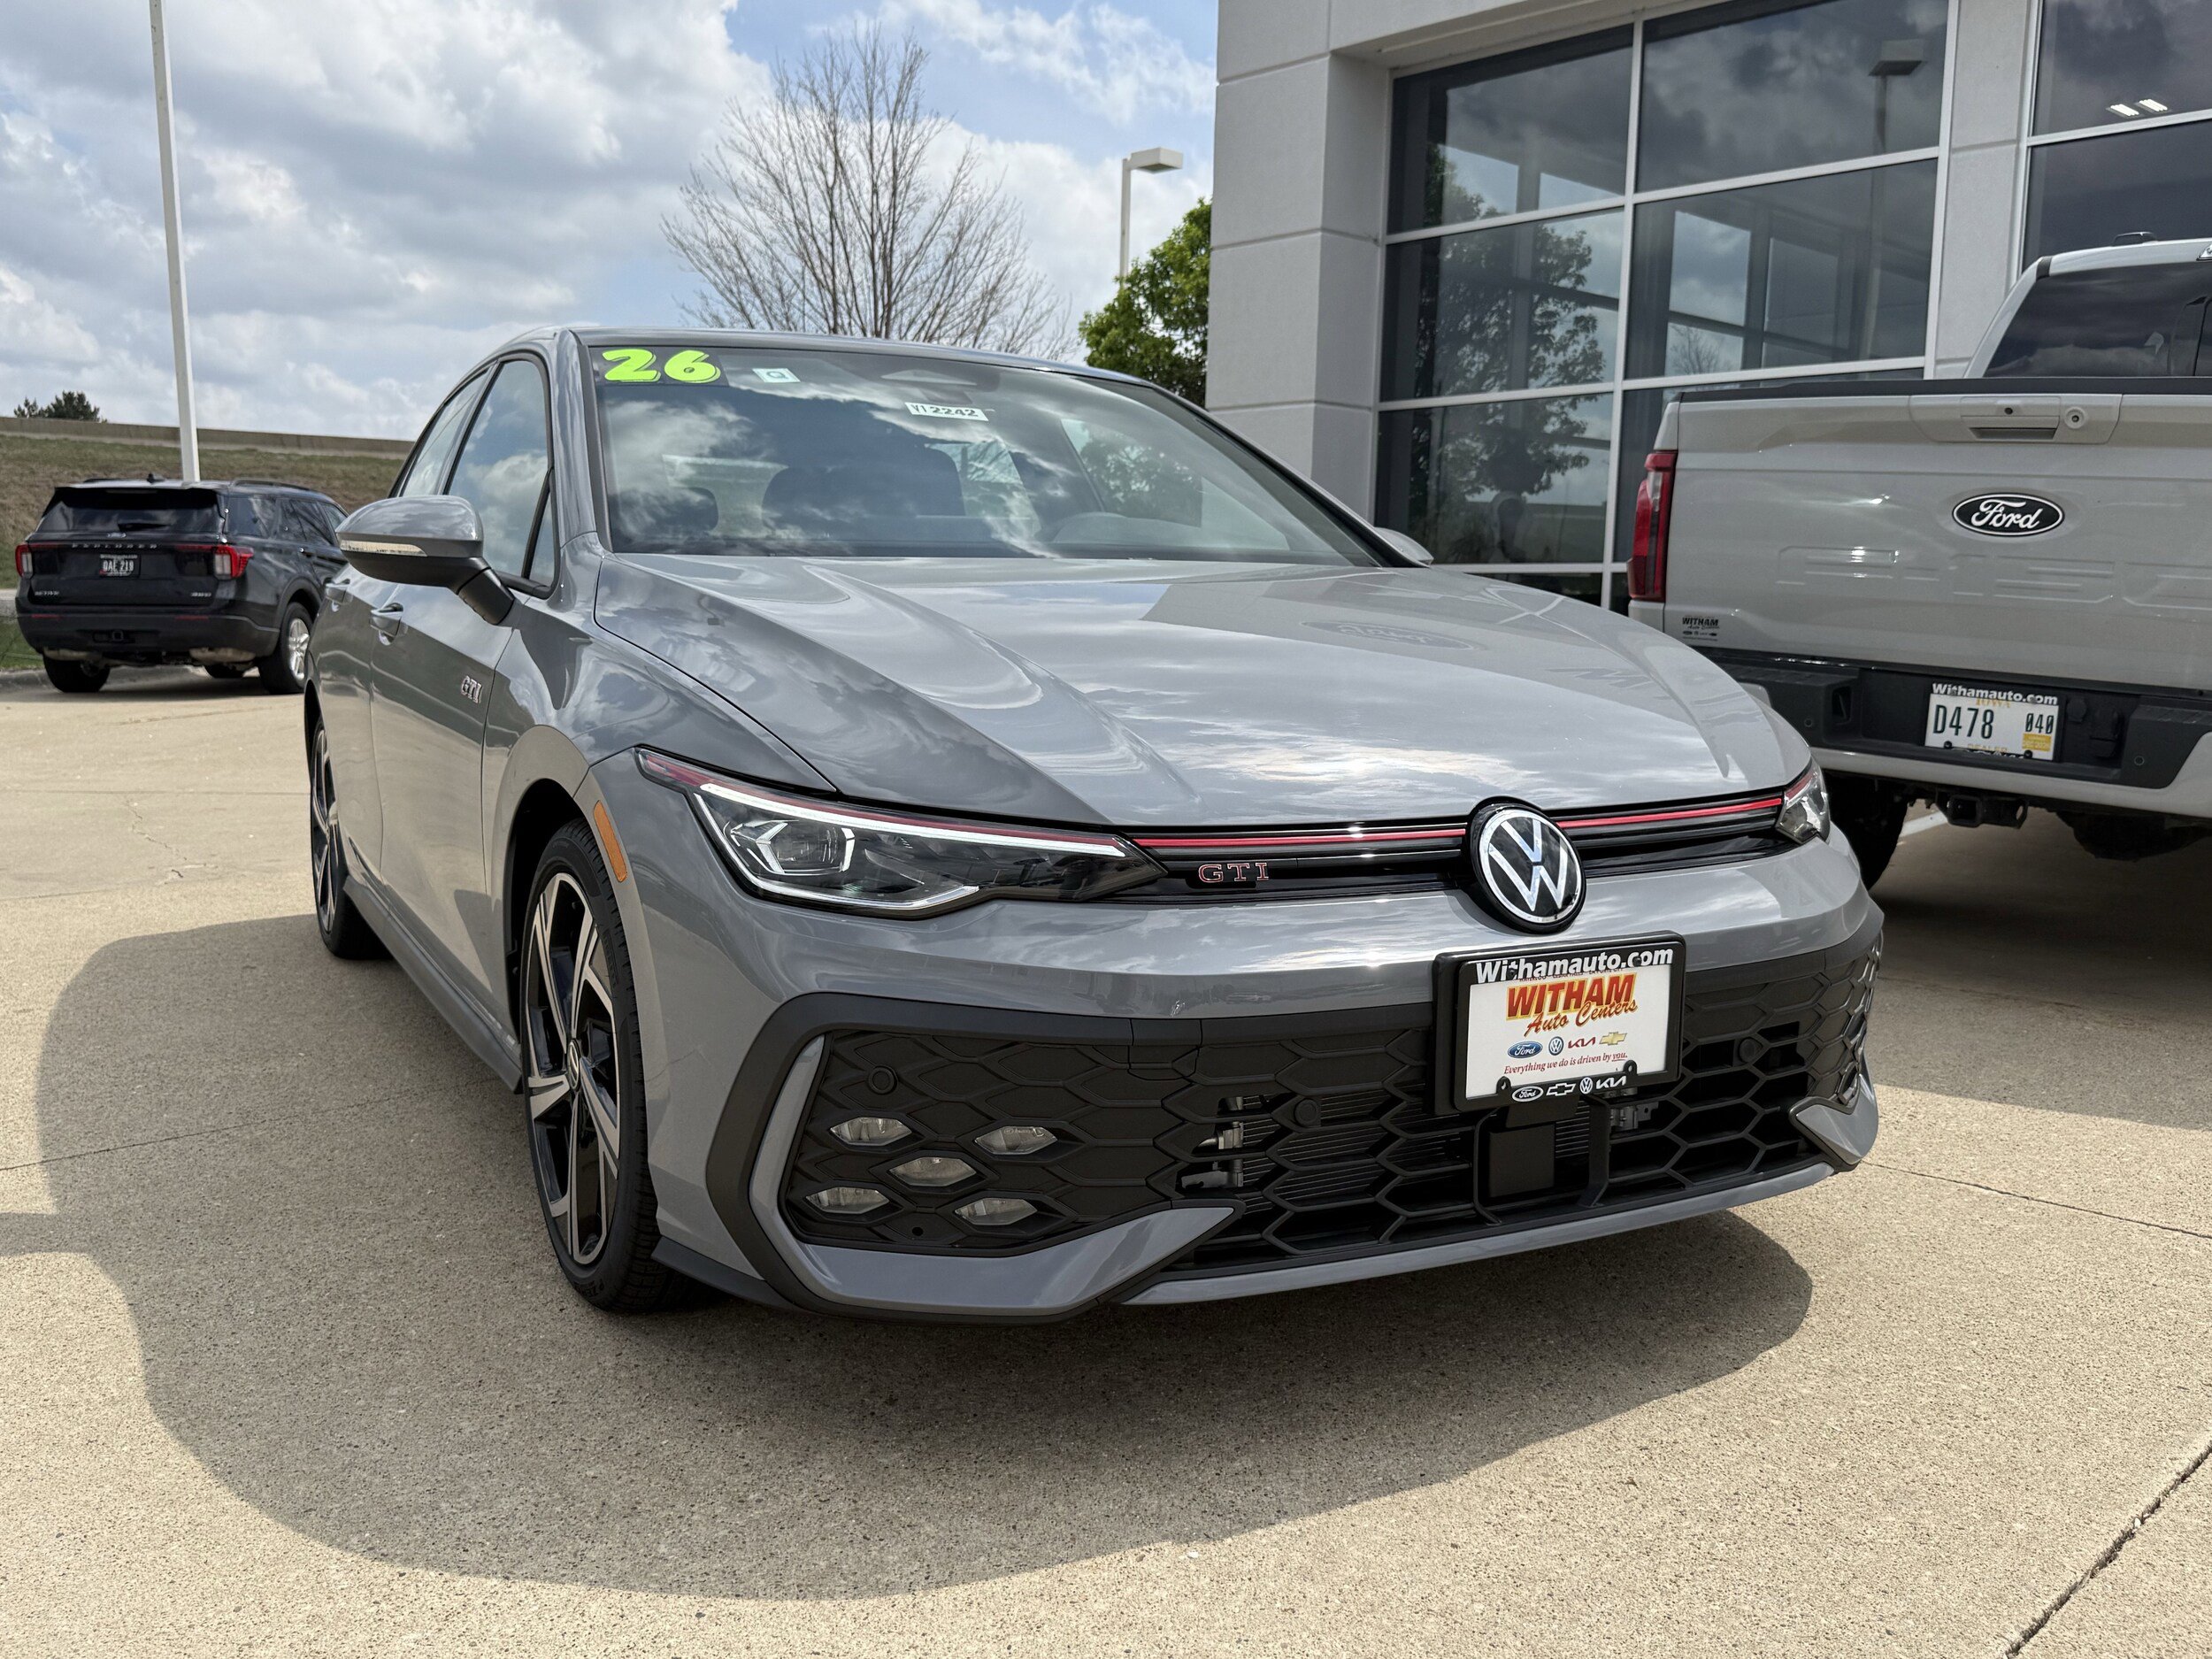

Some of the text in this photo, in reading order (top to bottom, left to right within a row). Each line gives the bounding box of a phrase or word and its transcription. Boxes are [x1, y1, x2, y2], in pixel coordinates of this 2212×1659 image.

[603, 349, 721, 383] 26
[1971, 499, 2044, 529] Ford
[461, 675, 482, 703] GTI
[1933, 704, 1994, 740] D478
[1198, 862, 1270, 883] GTI
[1507, 973, 1636, 1018] WITHAM
[1524, 1000, 1638, 1037] Auto Centers
[1504, 1062, 1546, 1074] Everything
[1548, 1060, 1557, 1069] we
[1559, 1057, 1569, 1066] do
[1570, 1056, 1576, 1065] is
[1578, 1054, 1601, 1064] driven
[1602, 1052, 1611, 1062] by
